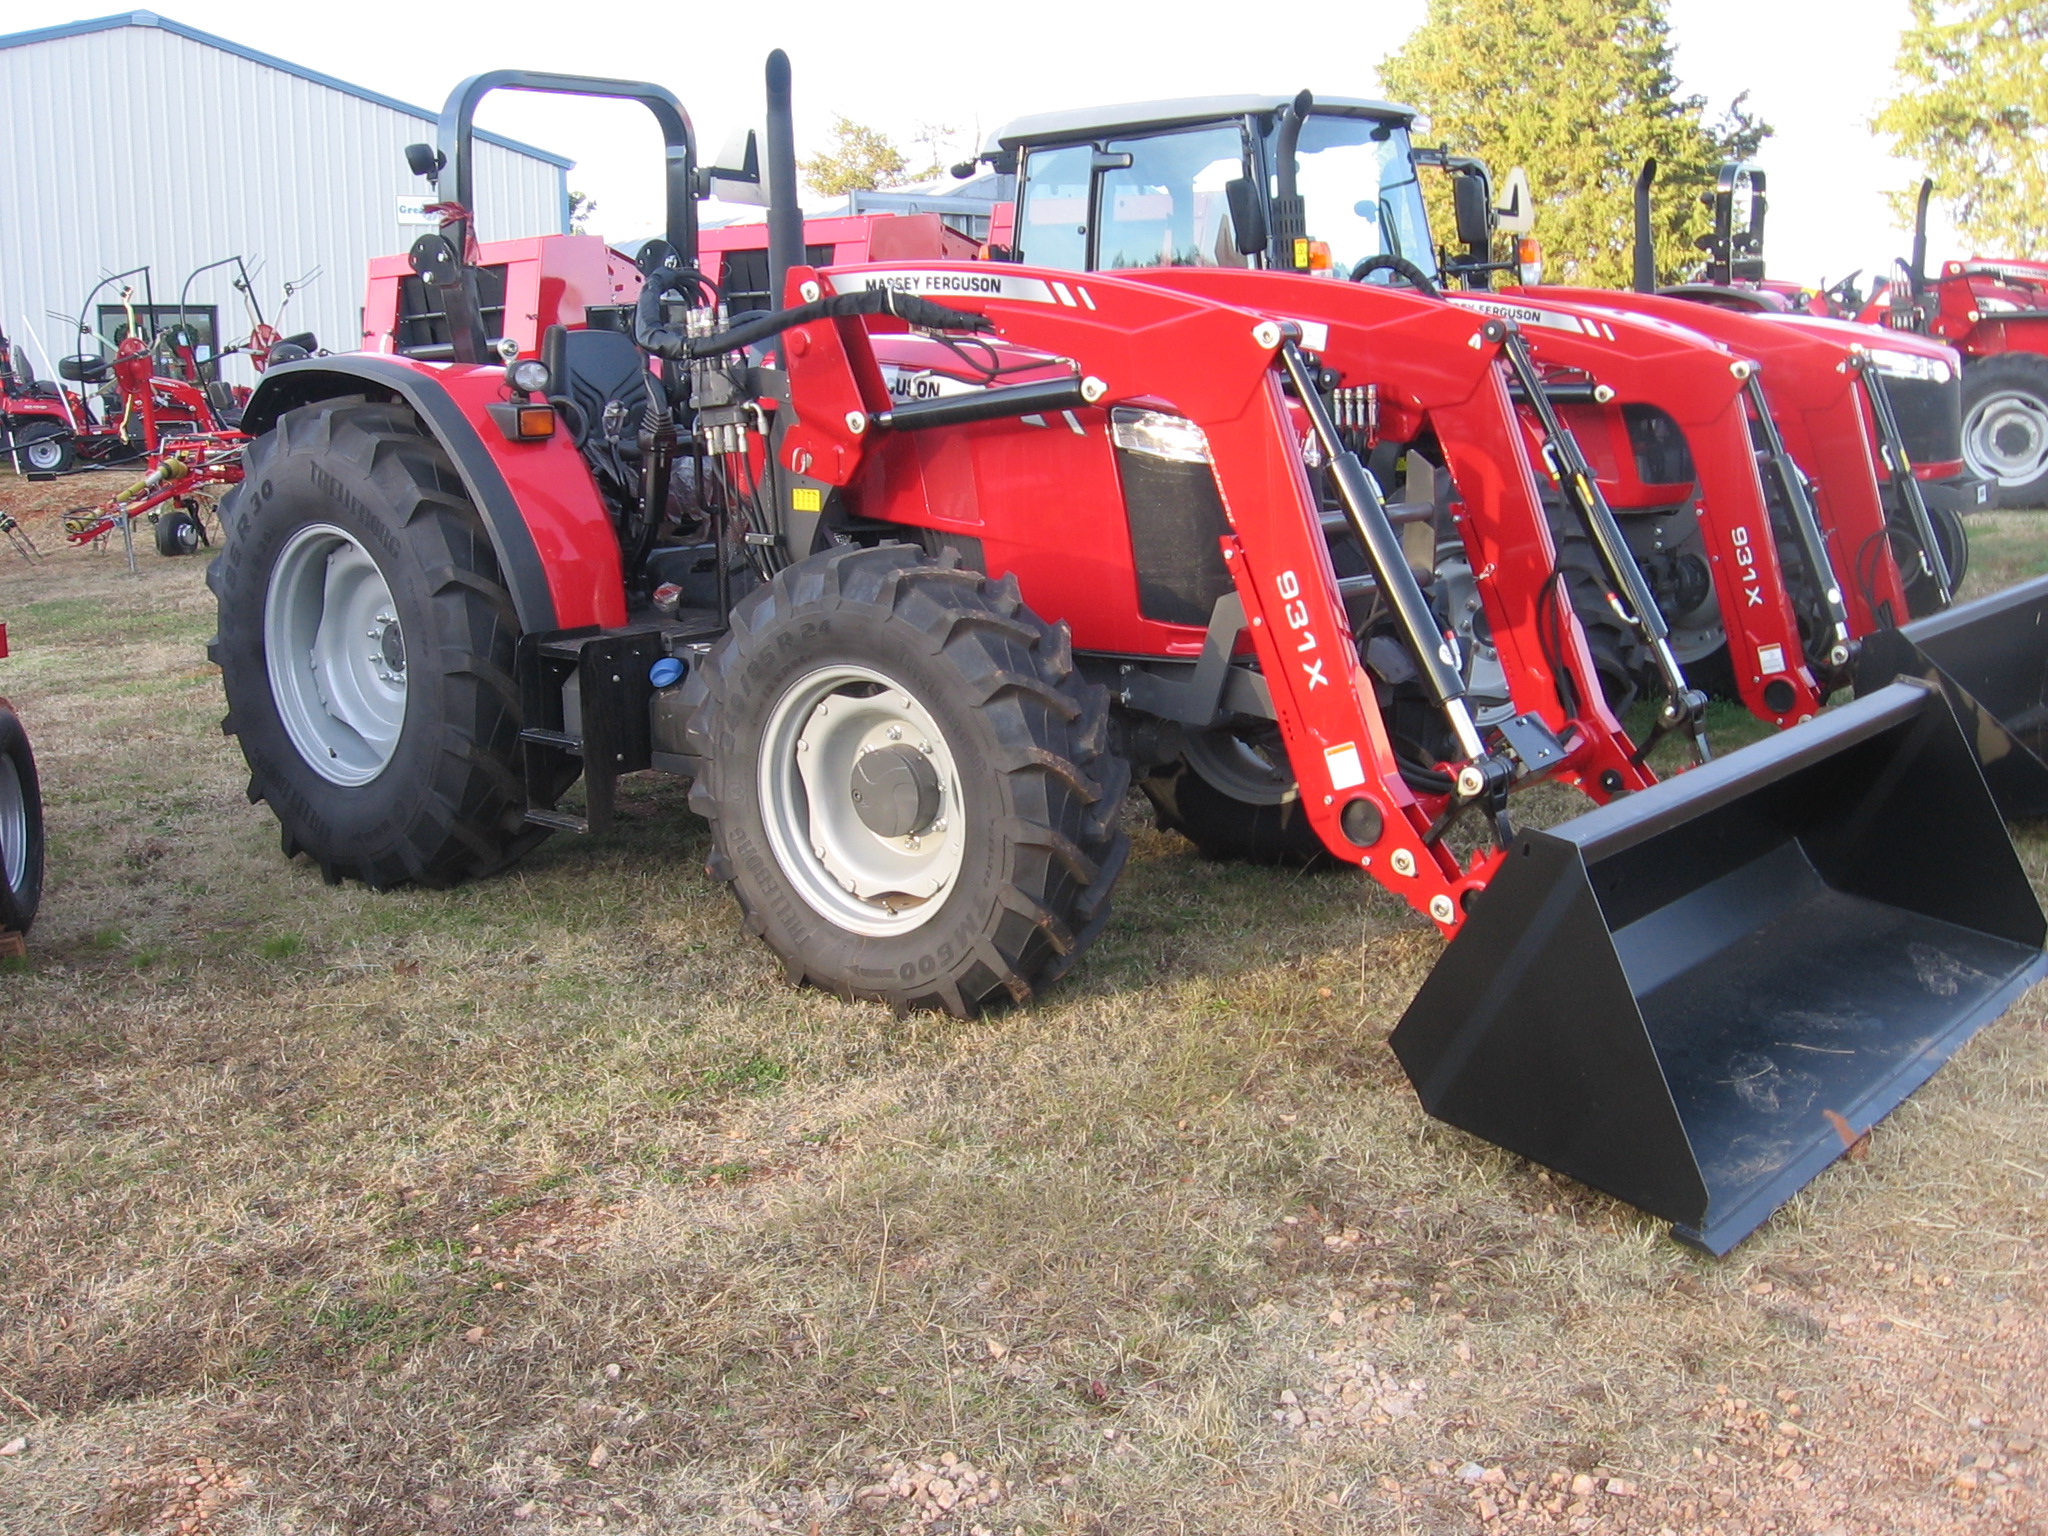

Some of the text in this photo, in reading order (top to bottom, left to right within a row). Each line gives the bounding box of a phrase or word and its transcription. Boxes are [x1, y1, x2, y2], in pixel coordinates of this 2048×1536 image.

[865, 277, 1001, 293] MASSEY FERGUSON
[251, 479, 274, 517] 30
[1731, 526, 1763, 608] 931X
[777, 631, 797, 653] R
[801, 620, 832, 641] 24
[1276, 570, 1329, 692] 931X
[729, 827, 812, 946] TRELLEBORG
